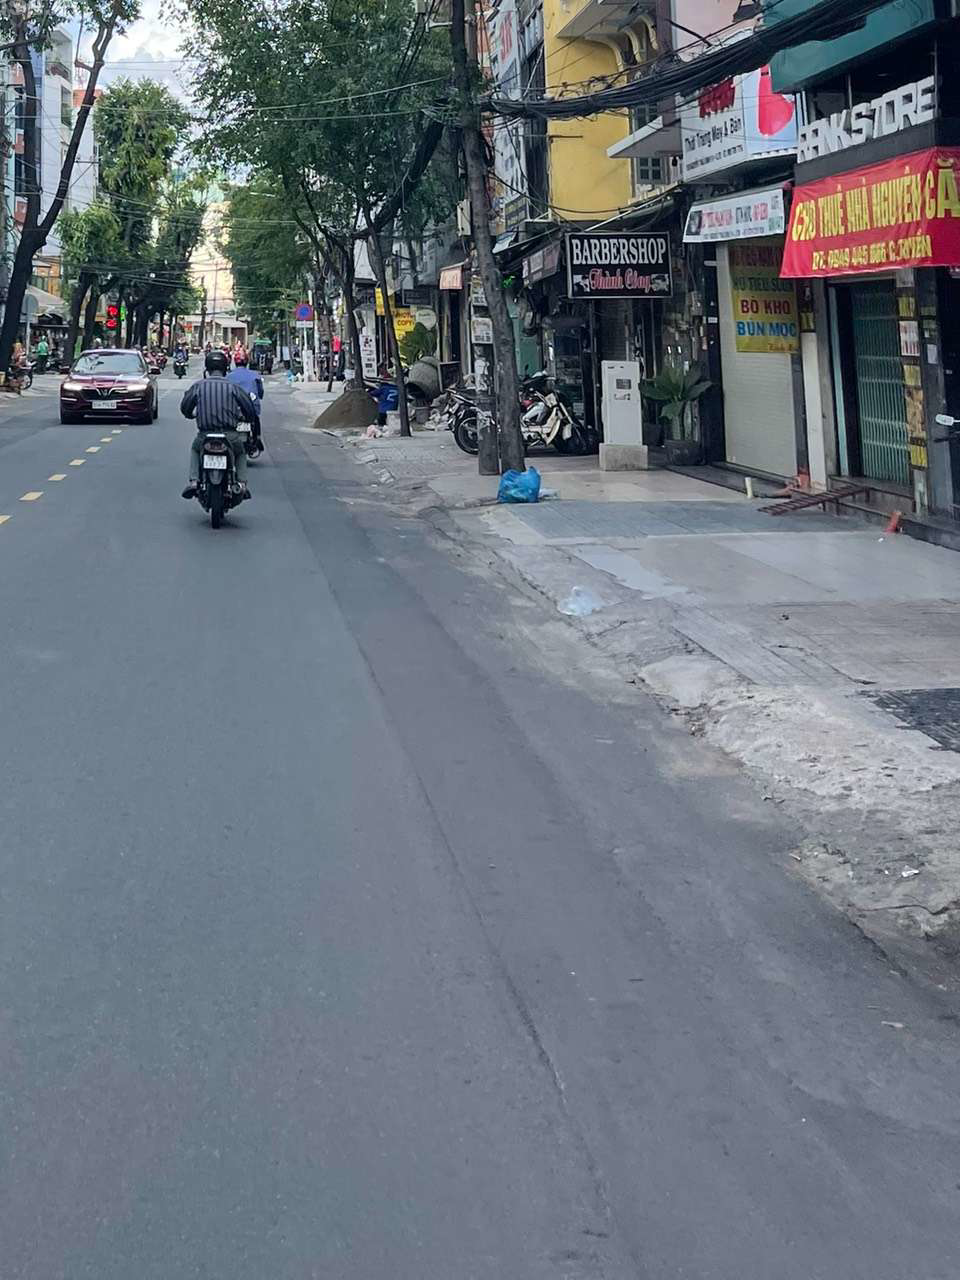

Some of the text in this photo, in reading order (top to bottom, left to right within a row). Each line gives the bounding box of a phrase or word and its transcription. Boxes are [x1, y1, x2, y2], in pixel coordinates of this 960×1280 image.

[792, 199, 817, 242] CHO
[818, 183, 845, 238] THUÊ
[845, 176, 871, 233] NHÀ
[871, 165, 922, 229] NGUYÊN
[571, 238, 667, 266] BARBERSHOP
[741, 295, 791, 315] BÒ KHO
